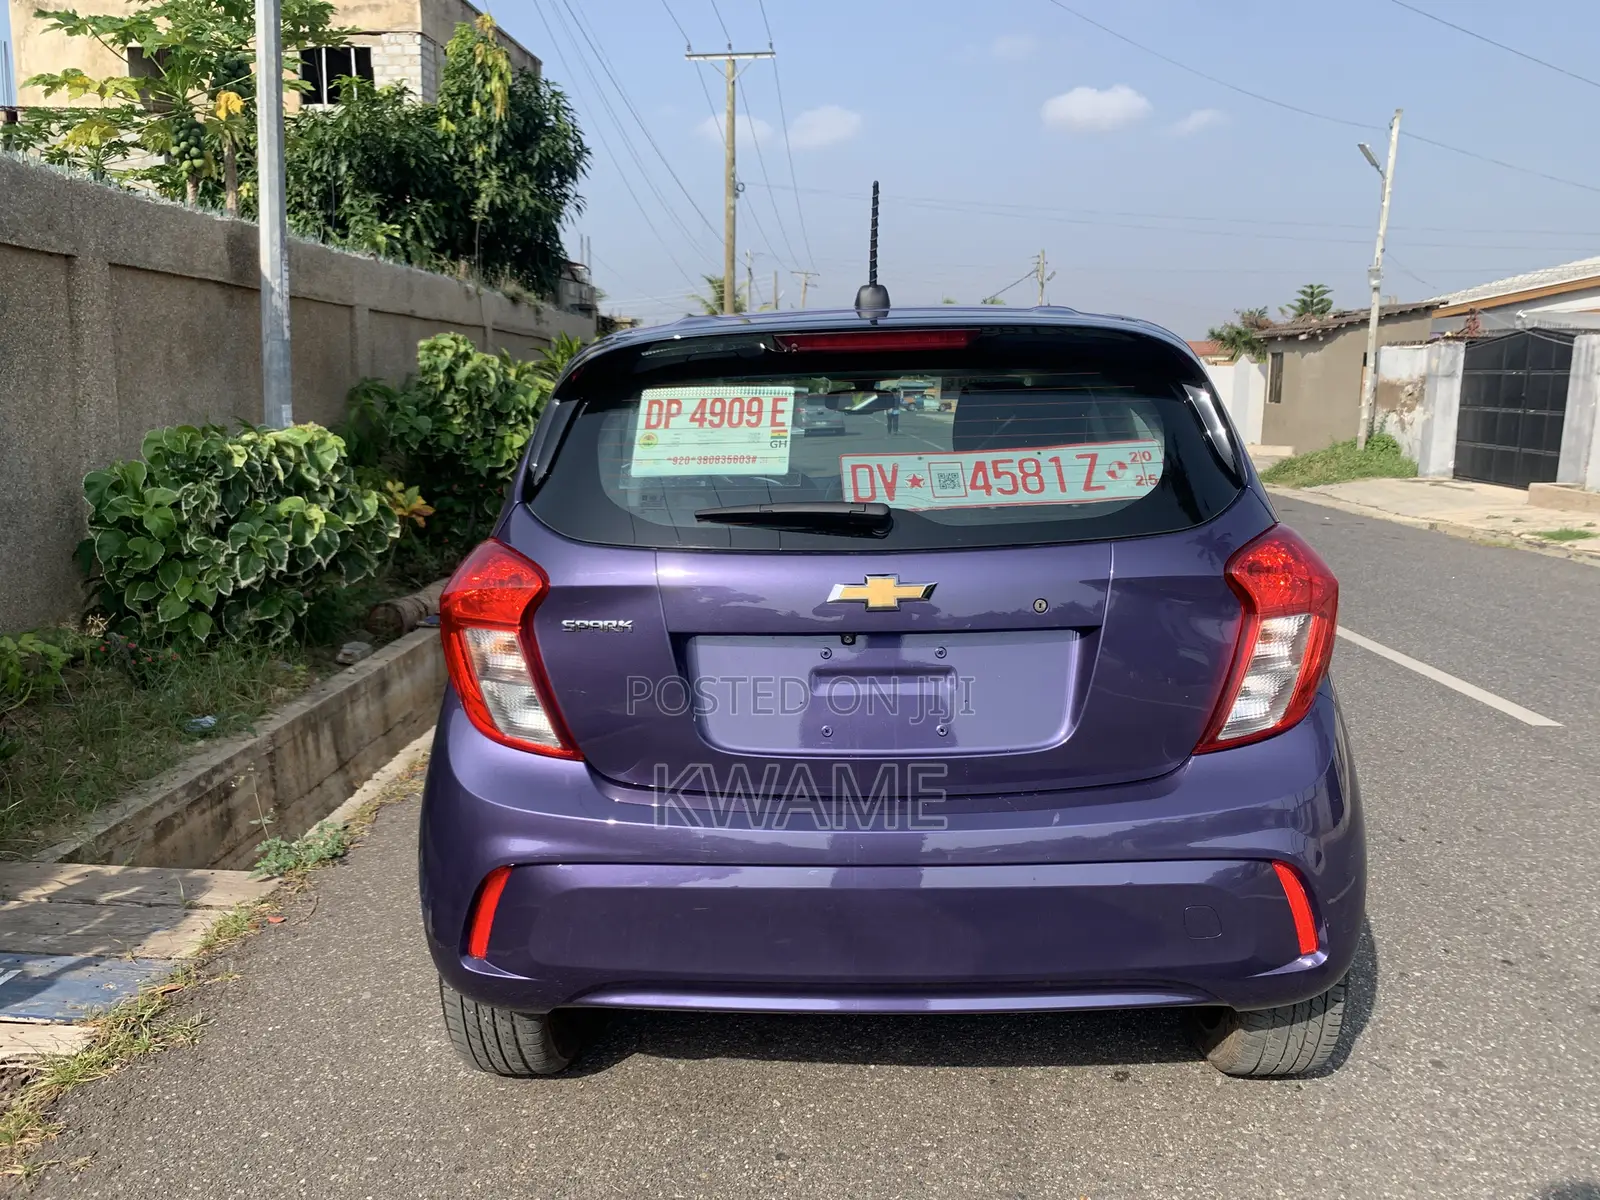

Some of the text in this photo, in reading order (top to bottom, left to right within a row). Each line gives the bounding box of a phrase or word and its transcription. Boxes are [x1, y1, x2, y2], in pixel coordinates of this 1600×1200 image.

[644, 396, 789, 430] DP 4909 E
[769, 439, 788, 449] GH
[850, 452, 1106, 502] DV 4581 Z
[561, 619, 634, 633] SPARK
